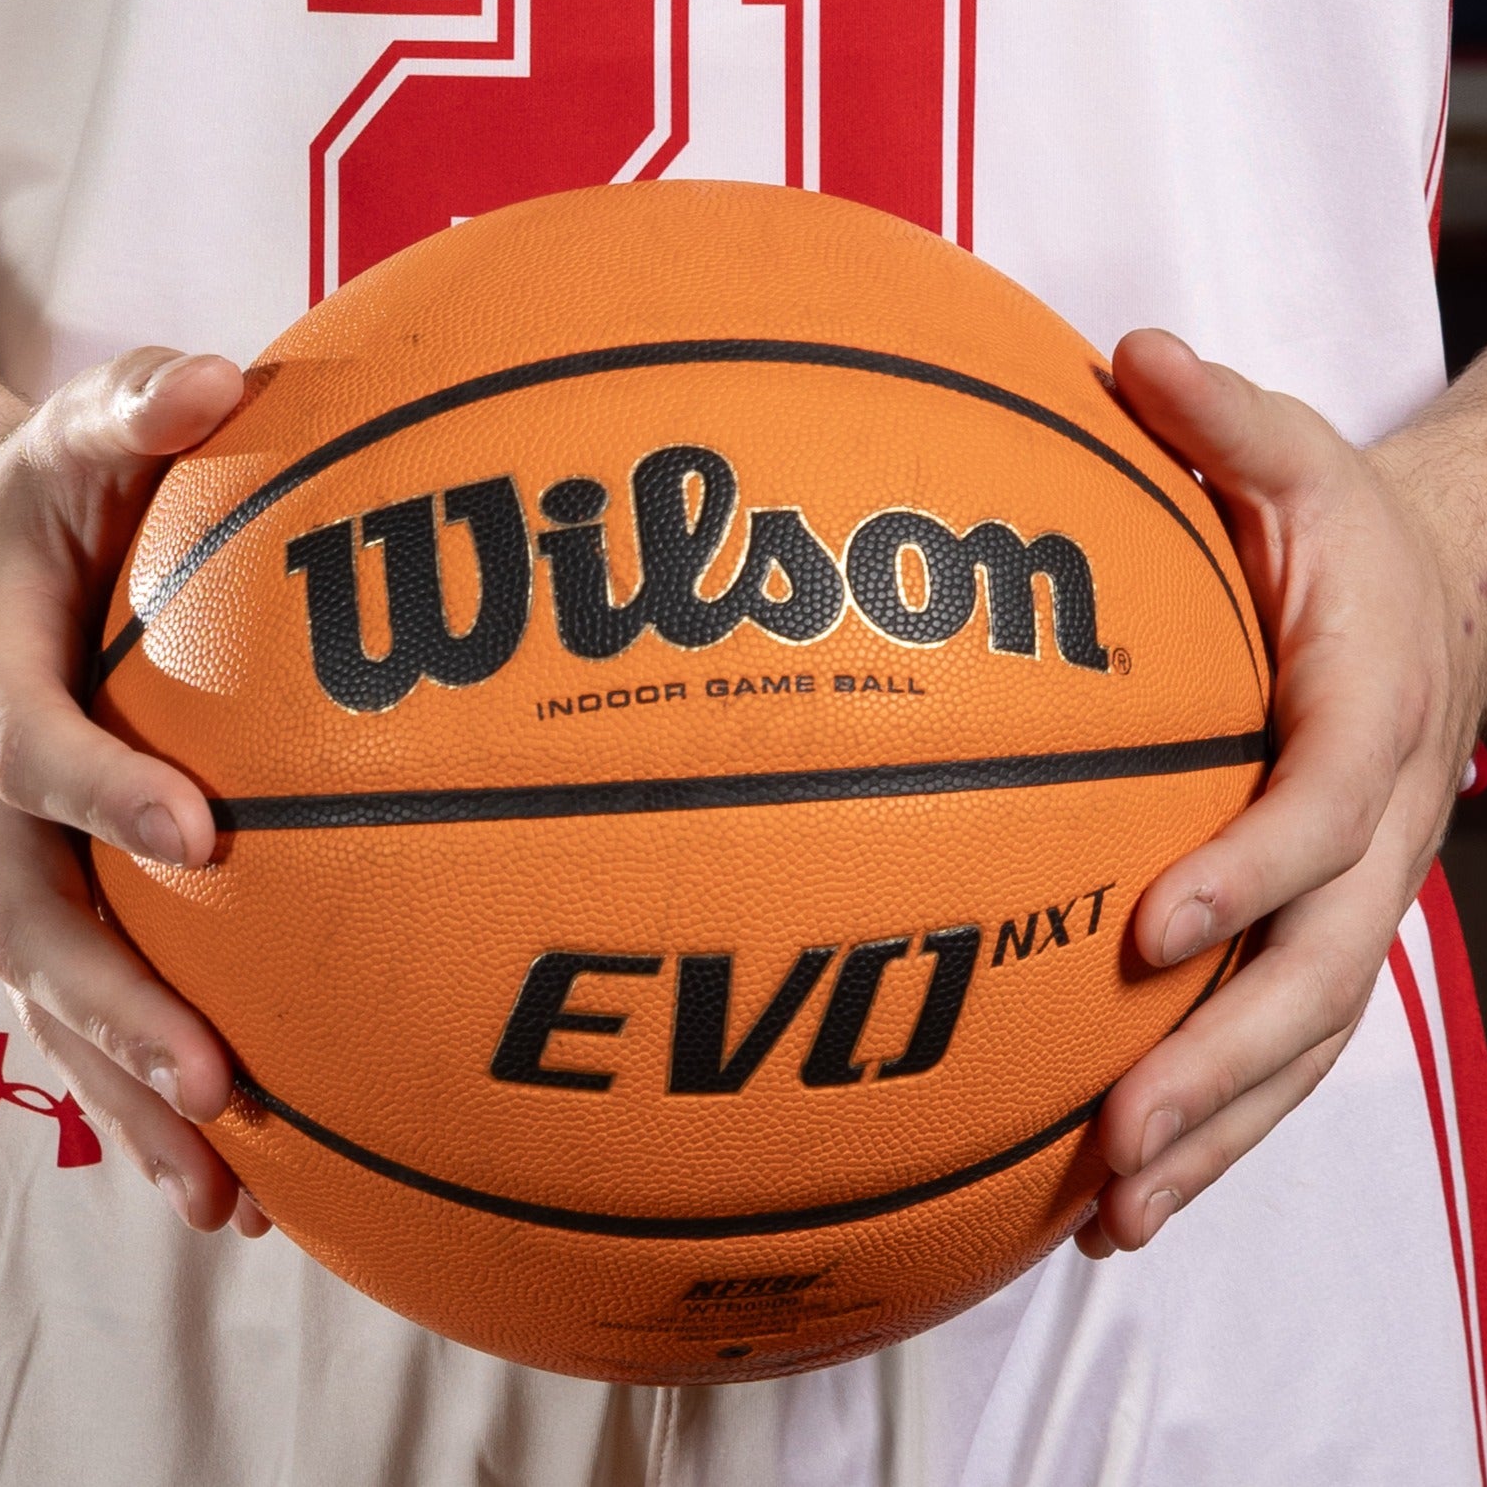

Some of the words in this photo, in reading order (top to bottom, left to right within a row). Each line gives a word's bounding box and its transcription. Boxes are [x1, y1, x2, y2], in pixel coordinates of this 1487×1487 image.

[285, 442, 1110, 716] Wilson
[536, 682, 688, 722] INDOOR
[704, 674, 816, 699] GAME
[833, 674, 927, 696] BALL
[489, 925, 982, 1096] EVO
[990, 883, 1116, 968] NXT
